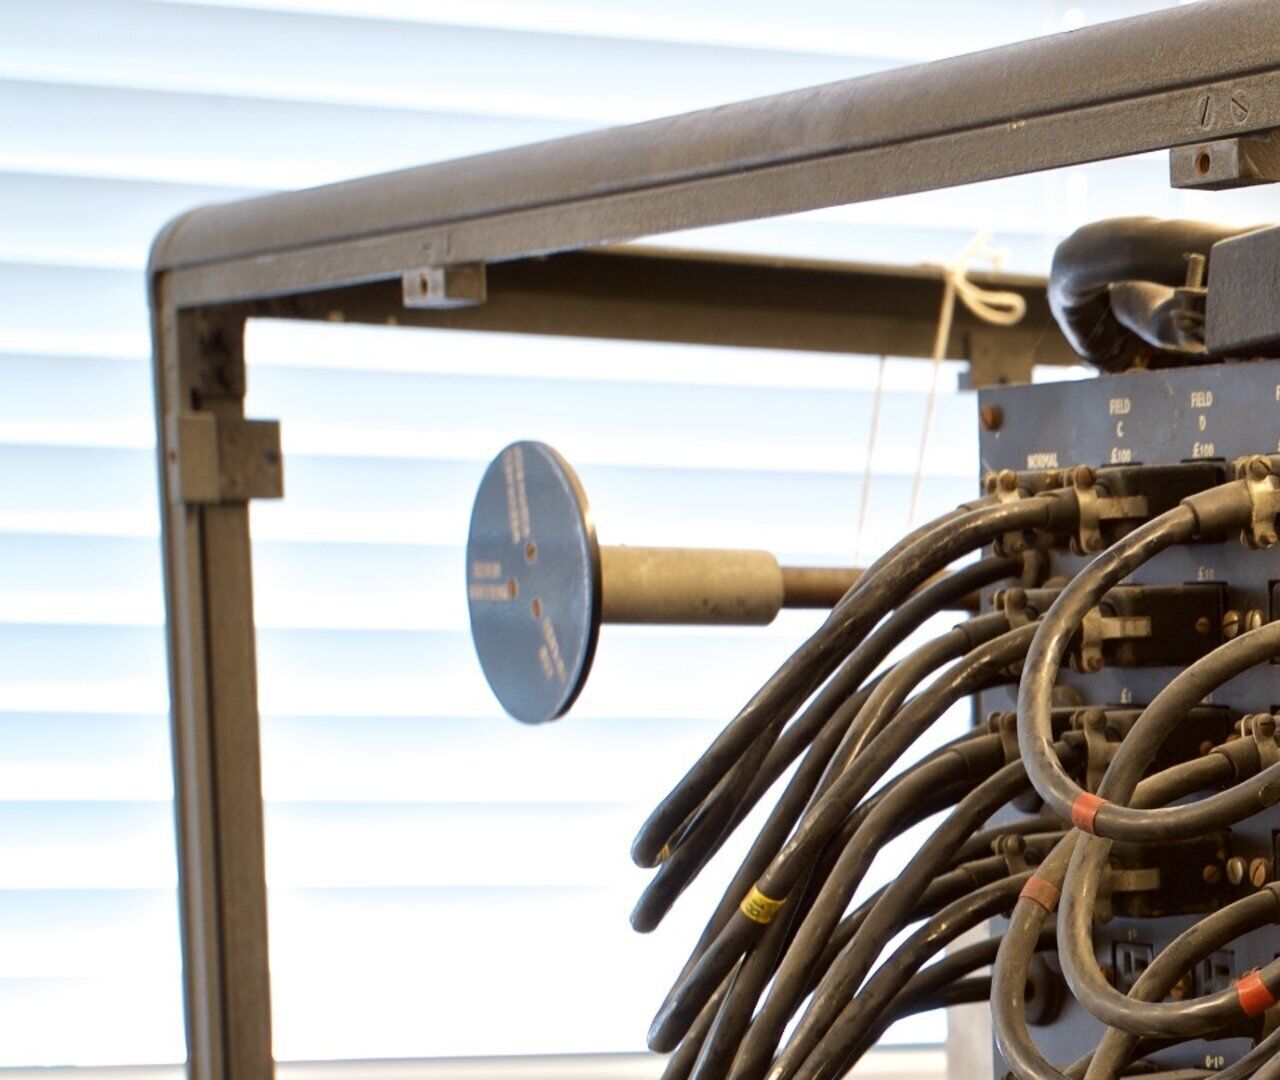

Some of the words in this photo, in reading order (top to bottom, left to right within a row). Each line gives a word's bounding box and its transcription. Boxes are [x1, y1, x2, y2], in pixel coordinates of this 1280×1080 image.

[1110, 398, 1131, 415] FIELD
[1191, 391, 1213, 408] FIELD
[1117, 421, 1124, 438] C
[1199, 415, 1206, 431] D
[1110, 446, 1131, 463] £100
[1192, 441, 1214, 458] £100
[1027, 452, 1058, 469] NORMAL
